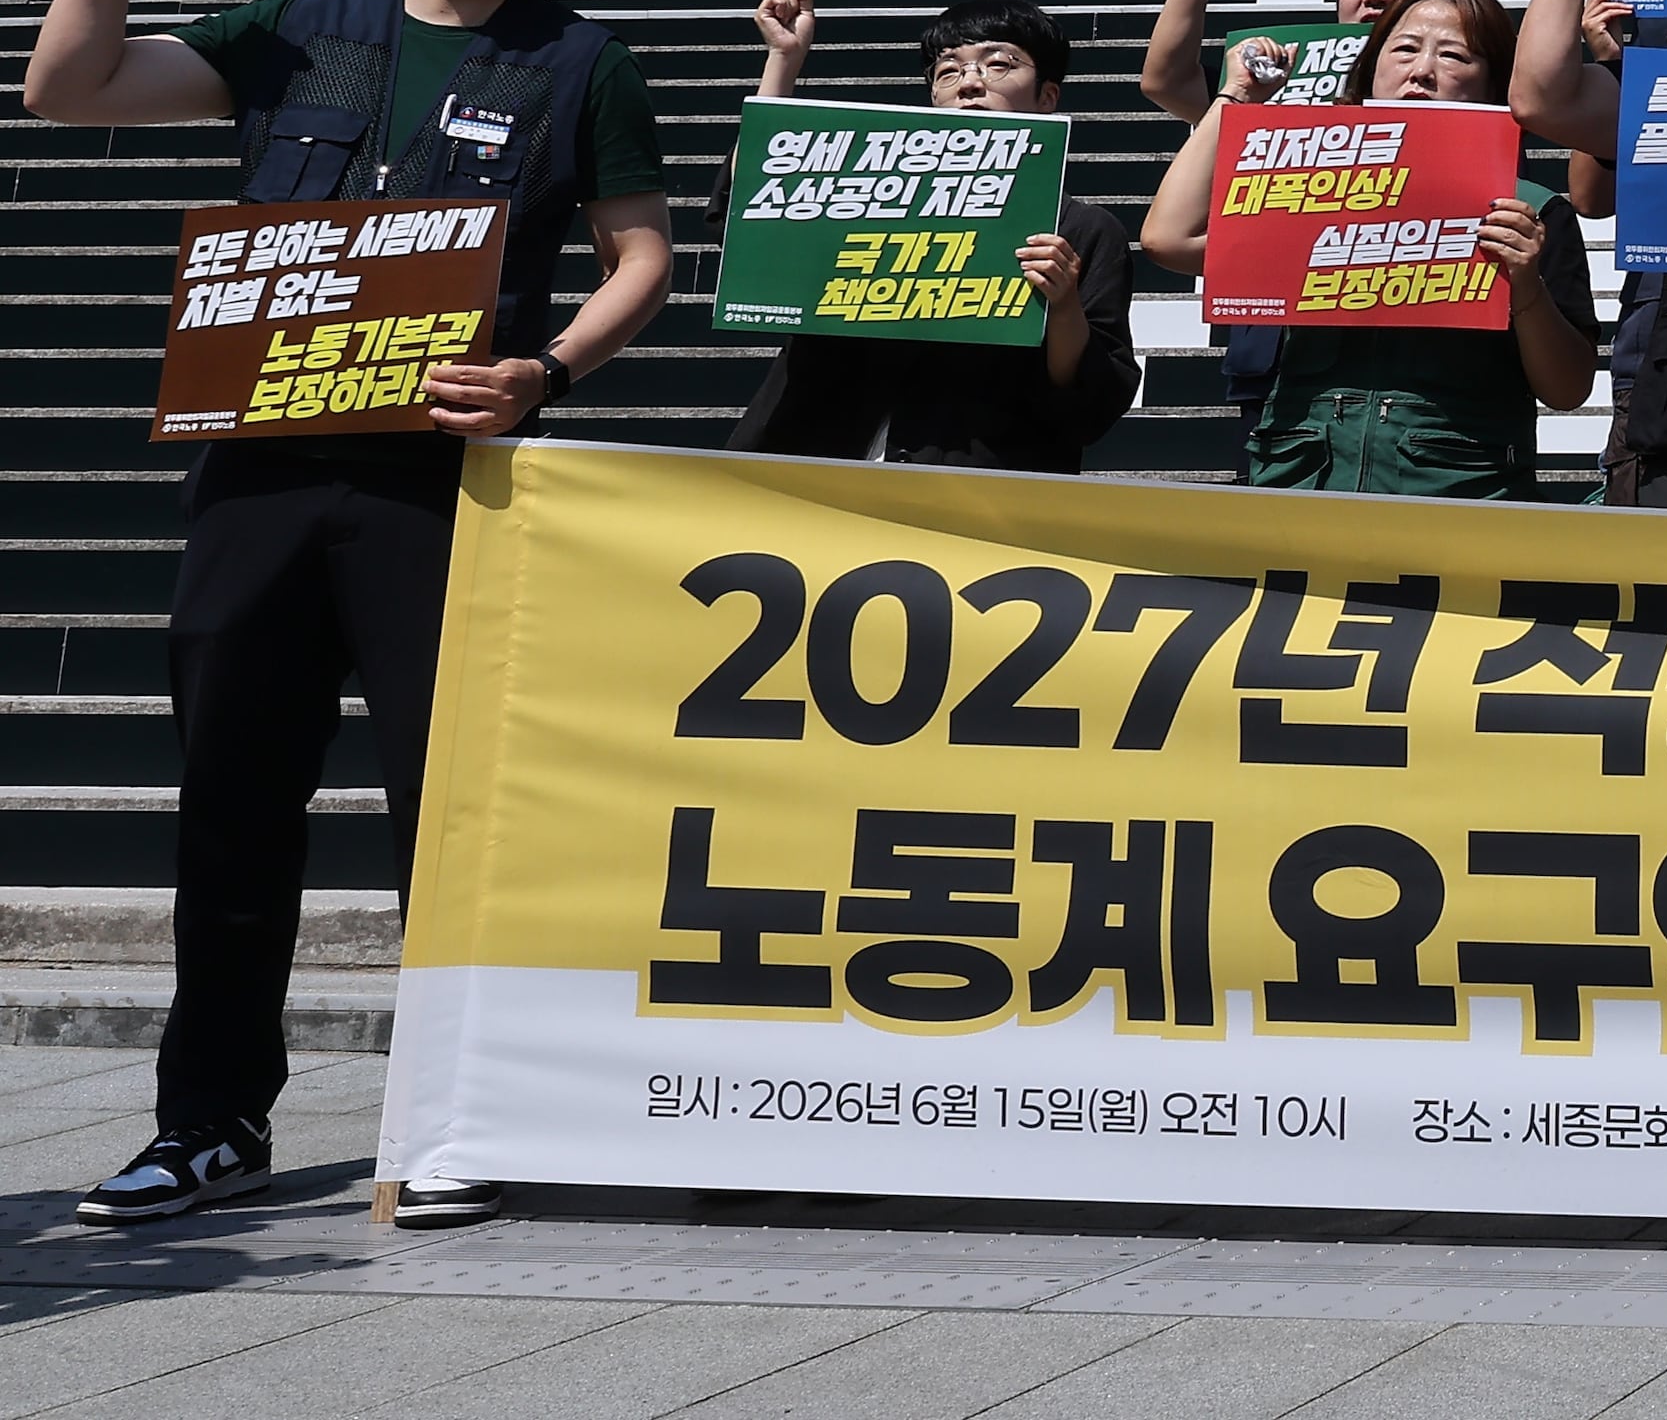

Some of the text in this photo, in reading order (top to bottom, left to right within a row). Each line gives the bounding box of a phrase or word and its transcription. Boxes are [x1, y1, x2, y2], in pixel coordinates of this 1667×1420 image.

[476, 109, 515, 125] 한국노총
[760, 129, 856, 175] 영세
[1234, 121, 1407, 171] 최저임금
[740, 173, 1016, 220] 소상공인 지원
[1220, 166, 1410, 216] 대폭인상!
[181, 205, 497, 280] 모든 일하는 사람에게
[834, 229, 977, 274] 국가가
[175, 268, 361, 331] 차별 없는
[814, 275, 1032, 322] 책임져라!!
[1294, 260, 1497, 311] 보장하라!!
[258, 309, 484, 374] 노동기본권
[673, 550, 1442, 768] 2027년
[649, 806, 1215, 1027] 노동계
[749, 1079, 901, 1126] 2026년
[912, 1084, 978, 1128] 6월
[993, 1087, 1148, 1135] 15일(월)
[1160, 1092, 1238, 1137] 오전
[1254, 1095, 1346, 1141] 10시
